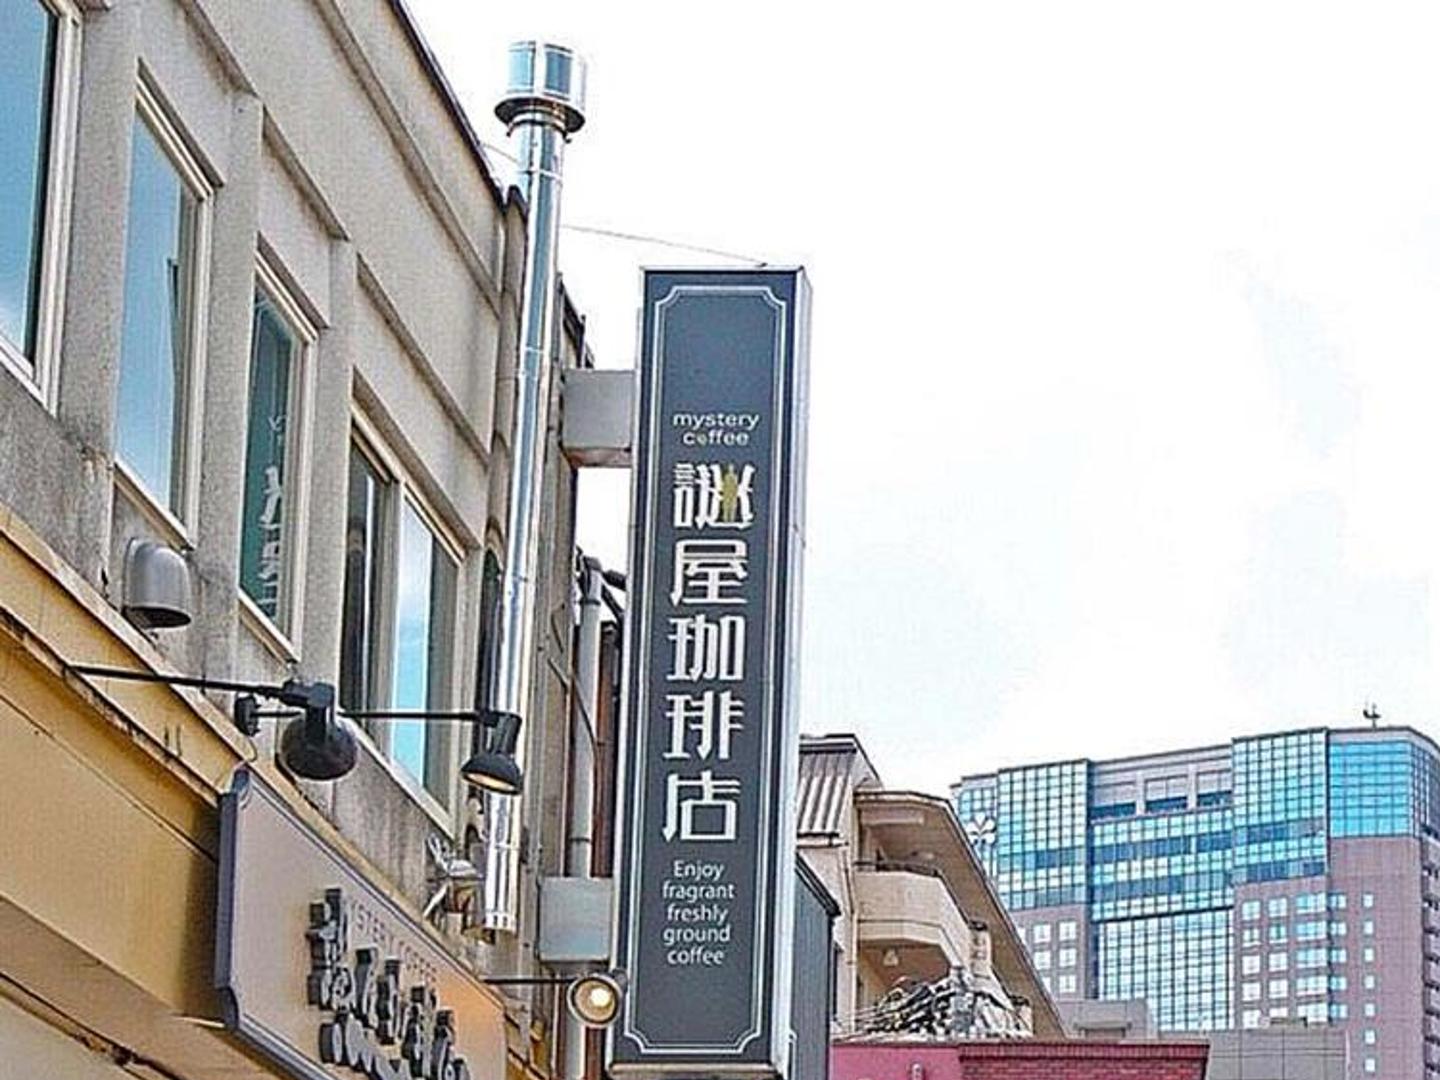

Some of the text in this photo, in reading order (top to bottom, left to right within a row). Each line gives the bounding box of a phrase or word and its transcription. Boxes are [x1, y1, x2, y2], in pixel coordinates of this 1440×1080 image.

[672, 413, 760, 431] mystery
[683, 430, 749, 446] coffee
[662, 462, 756, 843] 謎屋珈琲店
[673, 860, 725, 880] Enjoy
[662, 880, 736, 903] fragrant
[667, 903, 729, 926] freshly
[663, 924, 731, 946] ground
[667, 945, 724, 965] coffee
